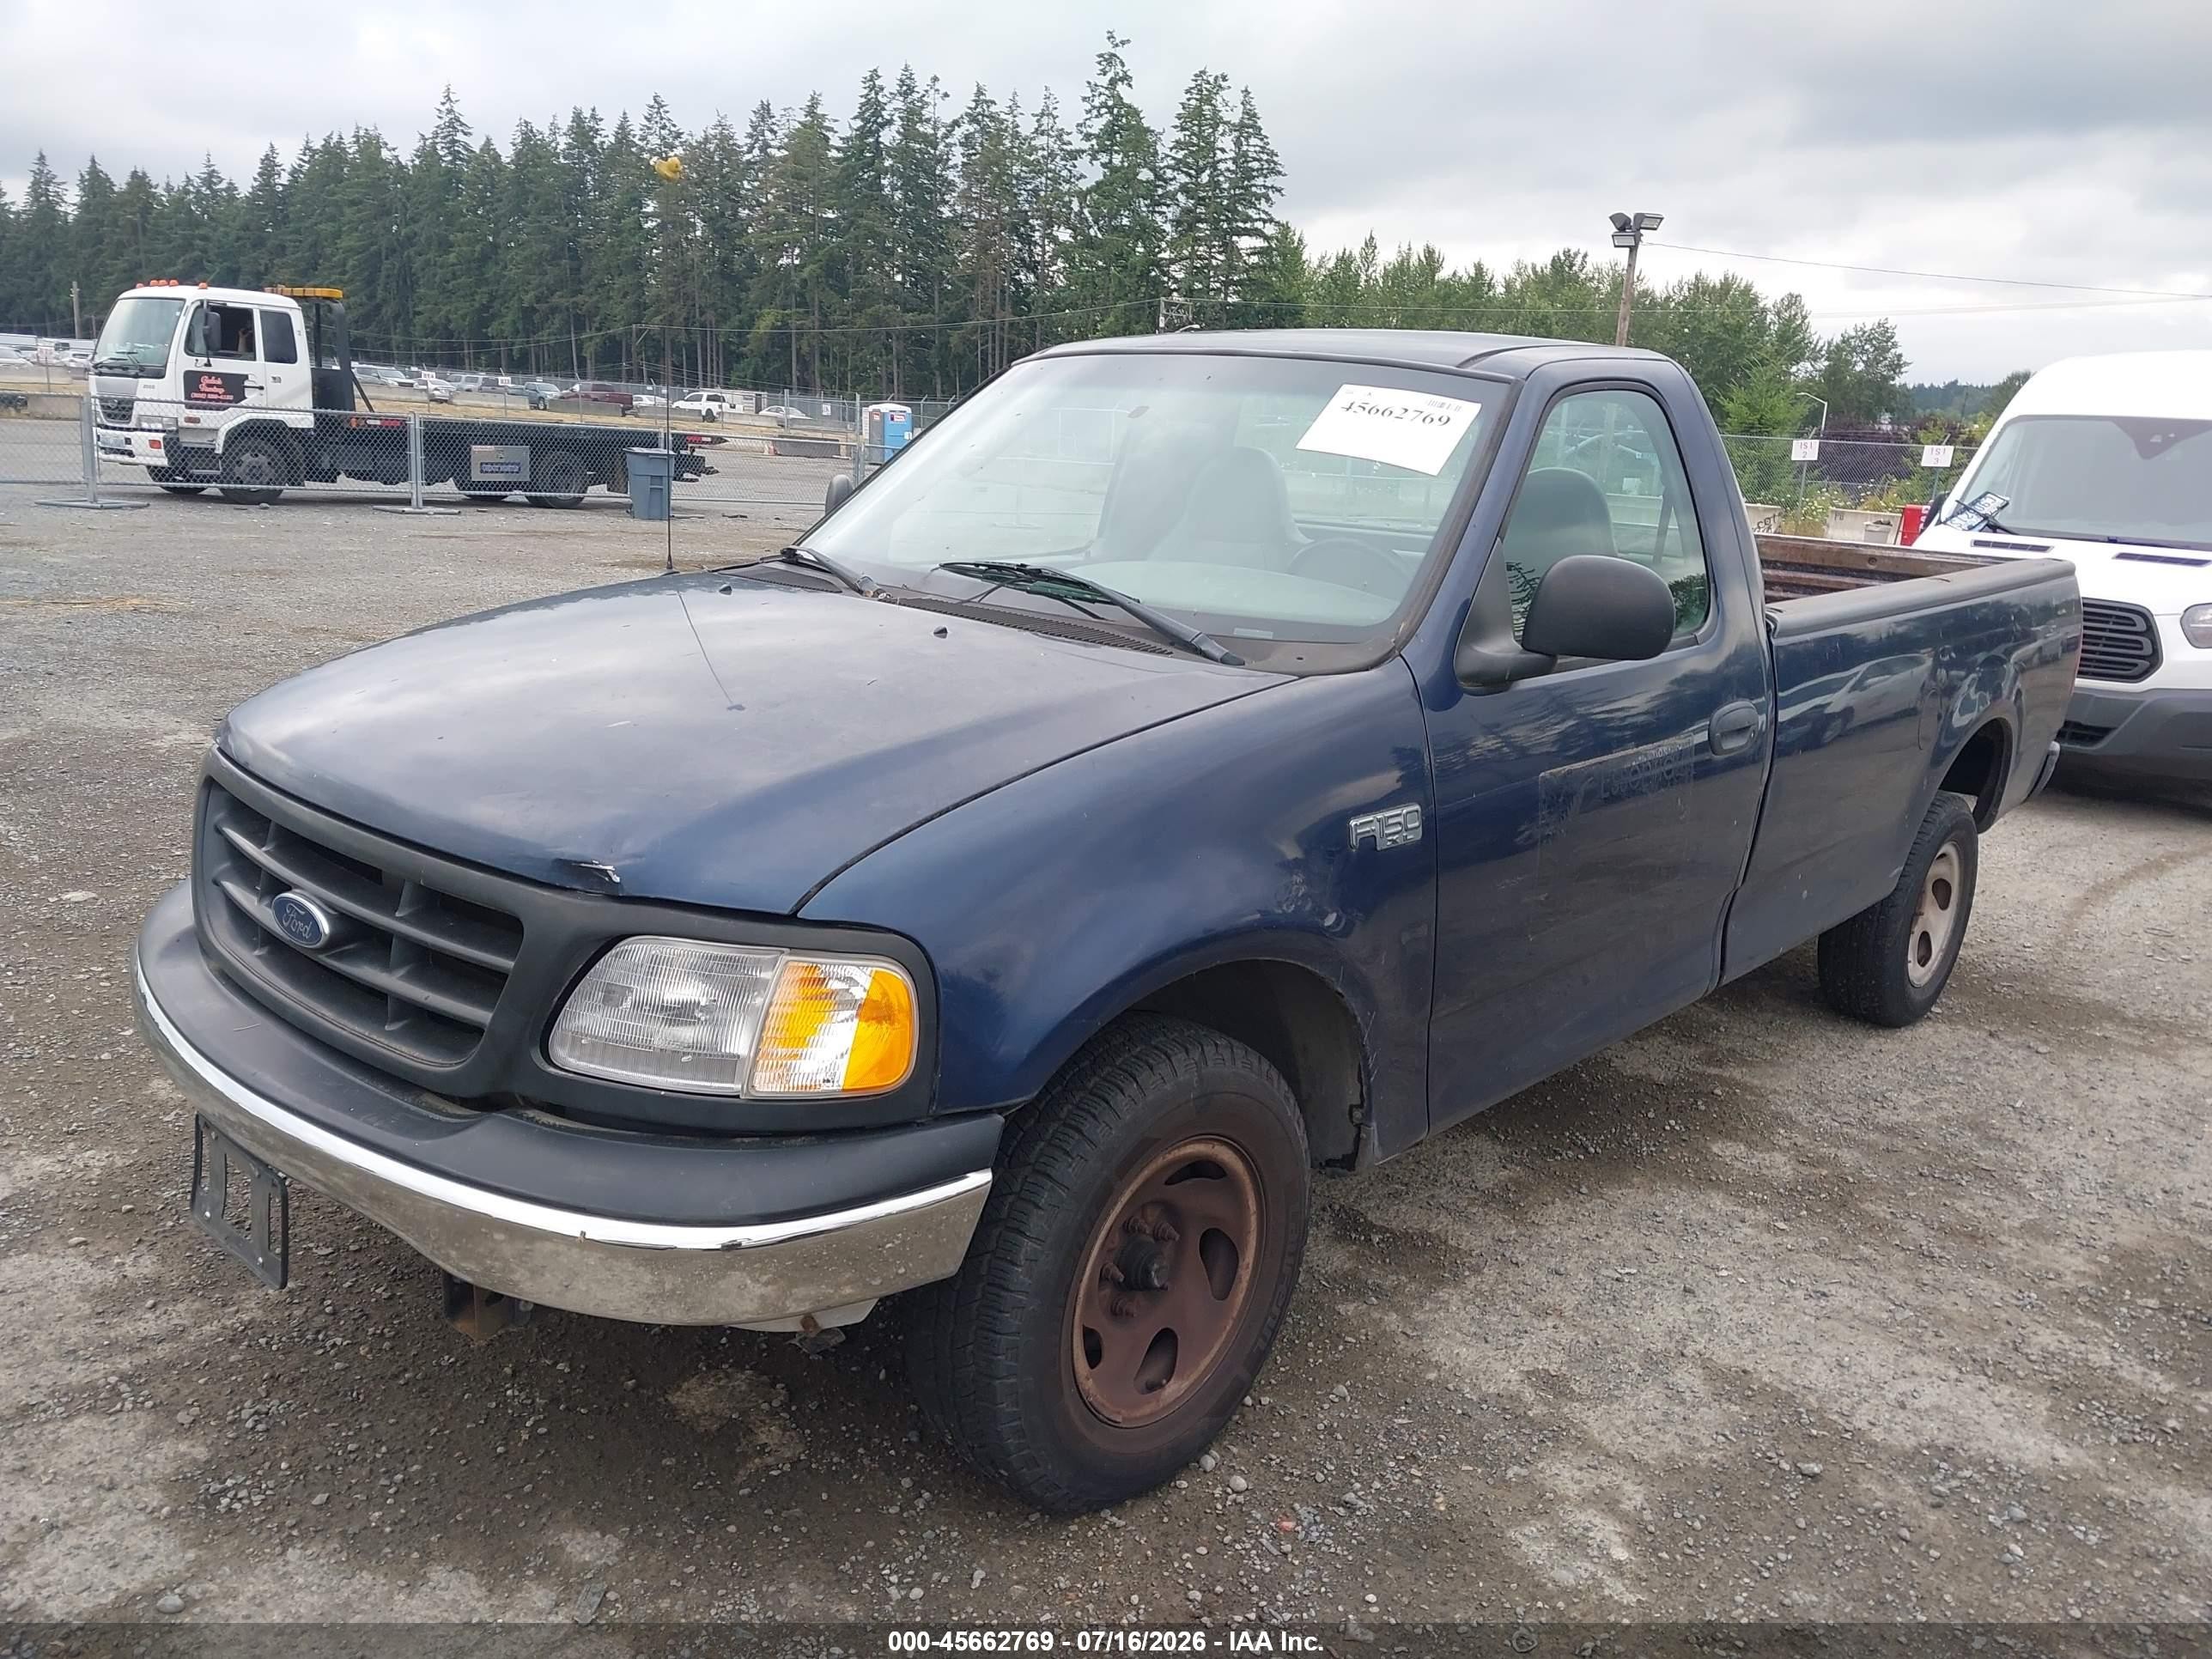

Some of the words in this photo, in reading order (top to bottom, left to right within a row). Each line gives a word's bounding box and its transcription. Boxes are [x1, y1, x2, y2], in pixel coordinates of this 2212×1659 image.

[1340, 400, 1451, 427] 45662769
[1386, 833, 1415, 847] XL
[282, 902, 313, 940] Ford
